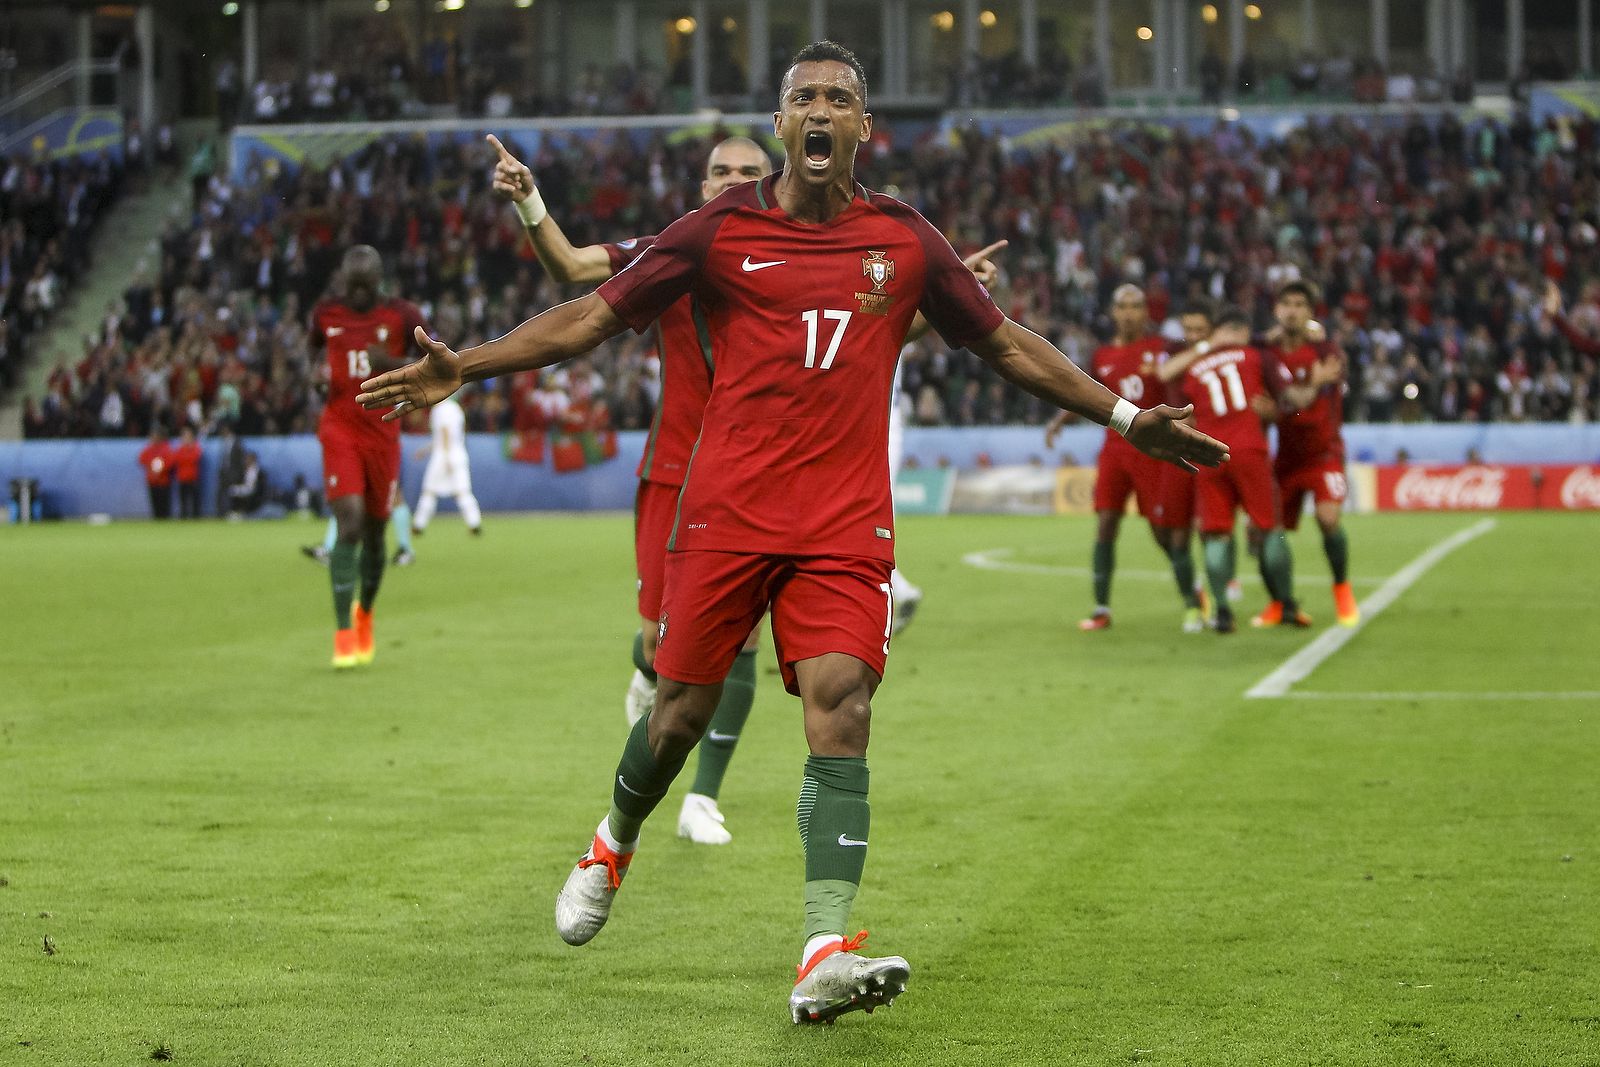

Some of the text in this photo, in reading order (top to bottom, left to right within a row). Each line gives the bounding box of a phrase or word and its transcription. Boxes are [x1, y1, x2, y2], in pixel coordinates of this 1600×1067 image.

[802, 309, 853, 370] 17
[1119, 373, 1144, 400] 10
[1199, 363, 1247, 416] 11
